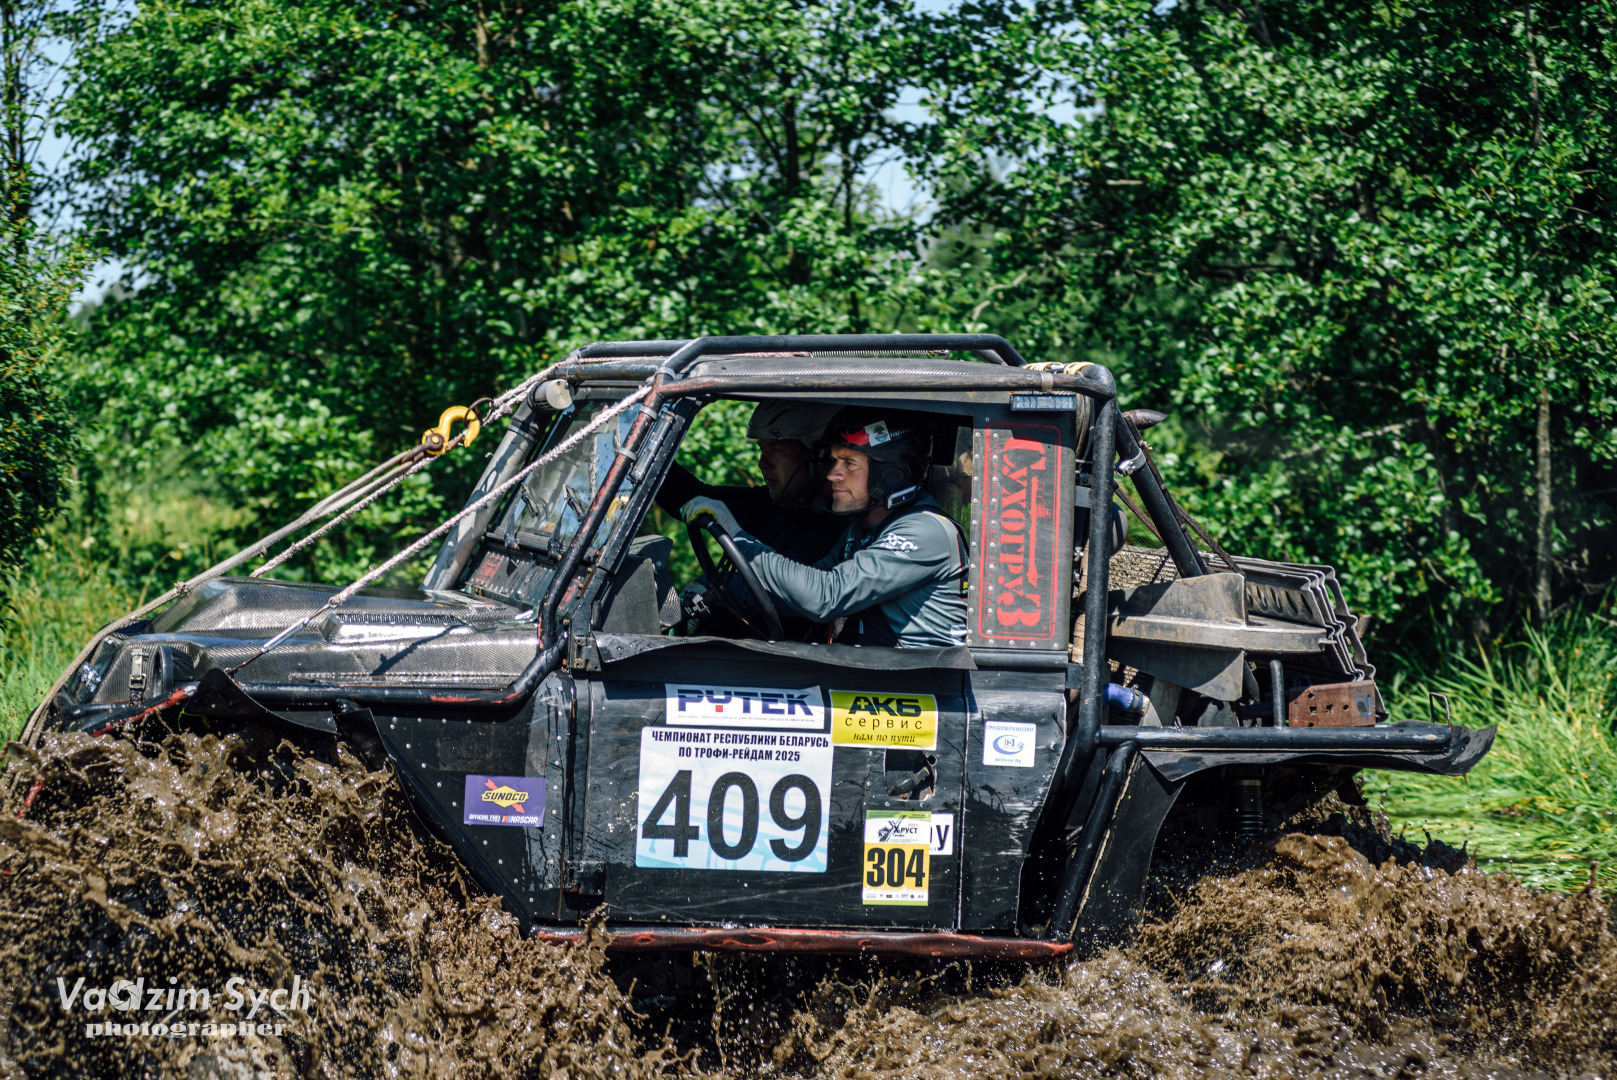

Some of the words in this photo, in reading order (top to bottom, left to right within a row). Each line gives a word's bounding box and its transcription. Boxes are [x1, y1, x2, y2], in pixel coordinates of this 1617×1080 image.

[848, 696, 922, 717] АКБ
[845, 717, 923, 731] сервис
[652, 730, 712, 743] ЧЕМПИОНАТ
[713, 733, 777, 746] РЕСПУБЛИКИ
[779, 736, 829, 748] БЕЛАРУСЬ
[853, 733, 874, 741] нам
[876, 734, 888, 742] по
[890, 735, 916, 744] пути
[678, 747, 692, 758] ПО
[694, 747, 773, 762] ТРОФИ-РЕЙДАМ
[775, 750, 801, 762] 2025
[484, 792, 527, 801] SUNOCO
[510, 816, 539, 824] NASCAR
[641, 769, 822, 862] 409
[867, 847, 925, 888] 304
